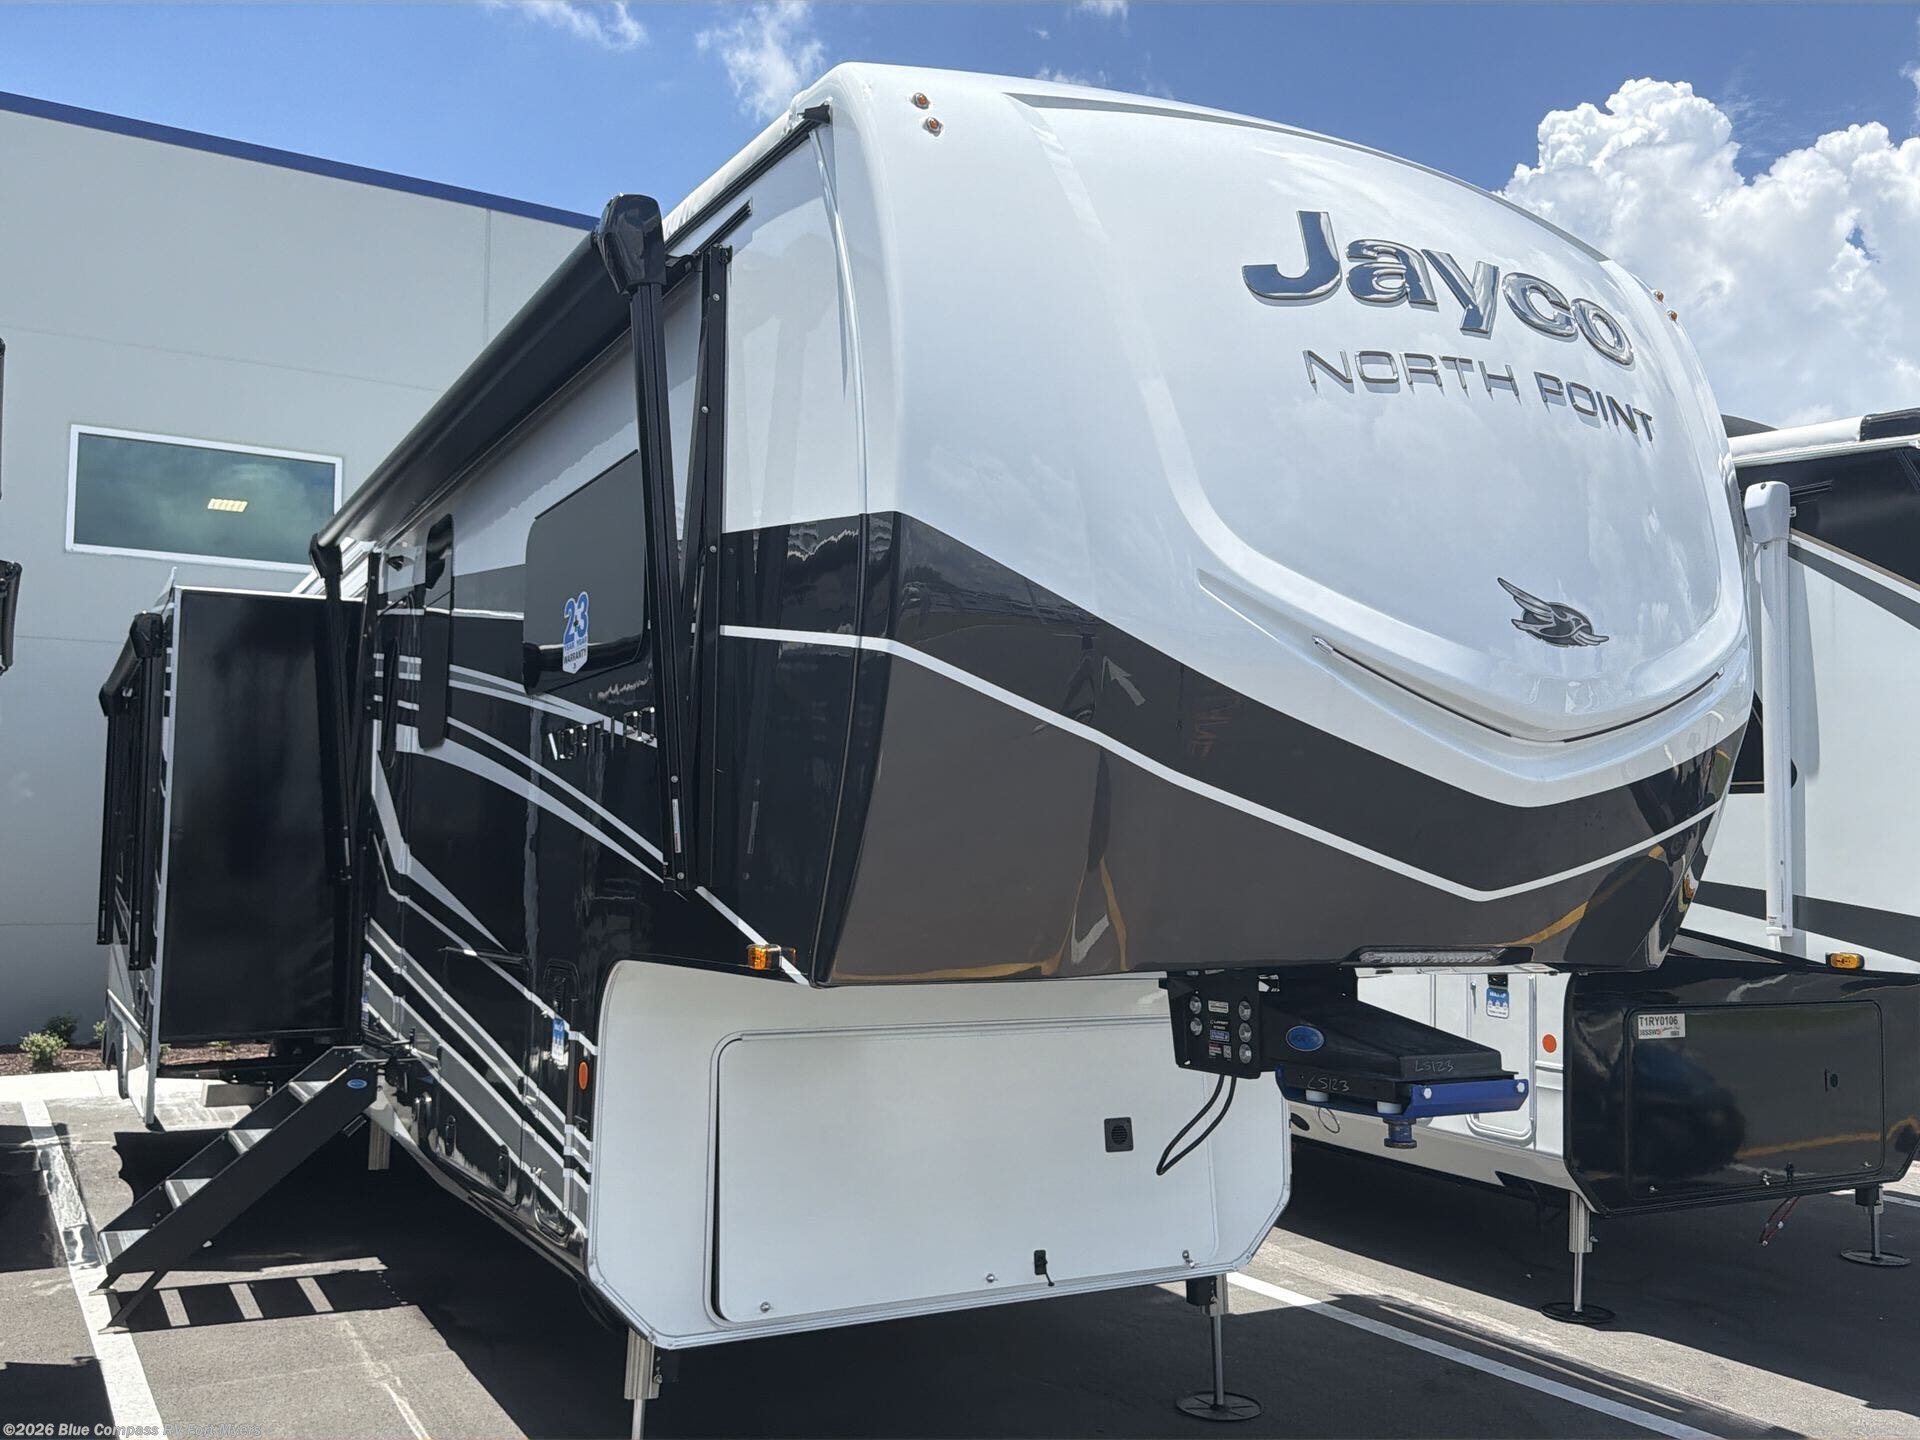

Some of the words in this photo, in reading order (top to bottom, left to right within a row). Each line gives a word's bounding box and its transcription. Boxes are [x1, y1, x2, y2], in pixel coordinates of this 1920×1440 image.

[1241, 210, 1636, 369] Jayco
[1302, 349, 1520, 398] NORTH
[1533, 371, 1653, 442] POINT
[563, 648, 587, 664] WARRANTY
[1638, 1015, 1679, 1026] T1RY0106
